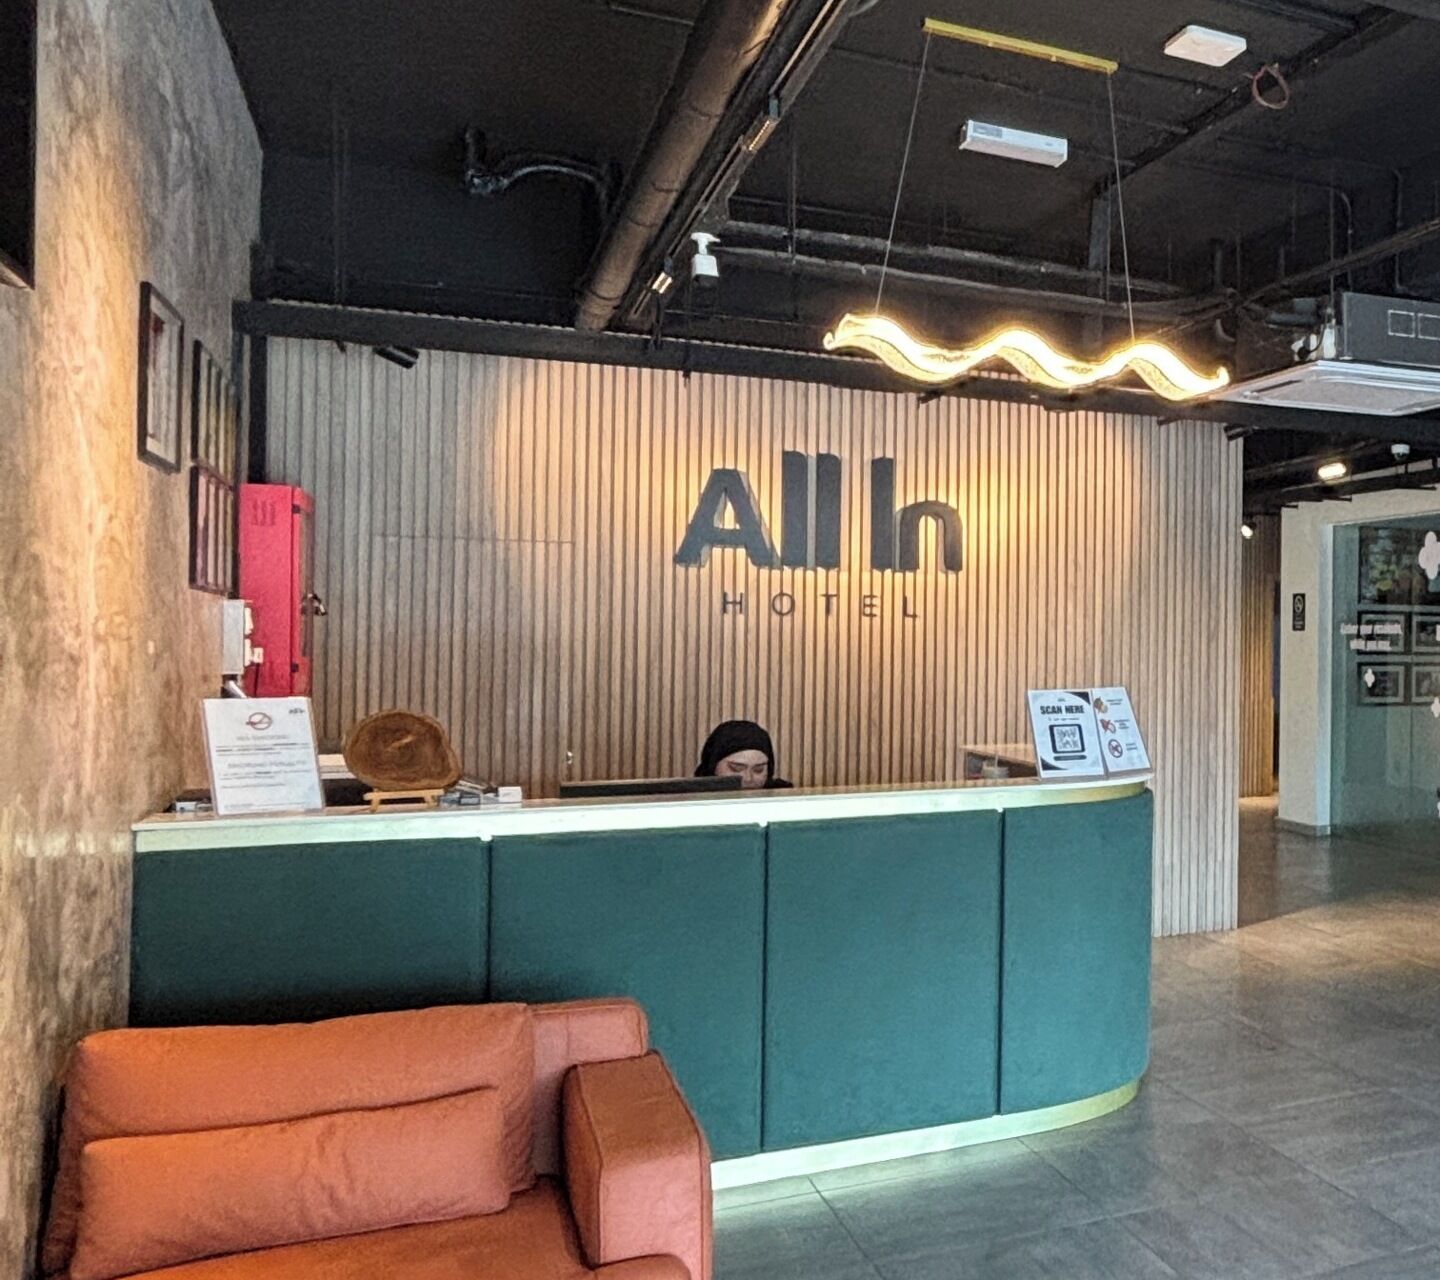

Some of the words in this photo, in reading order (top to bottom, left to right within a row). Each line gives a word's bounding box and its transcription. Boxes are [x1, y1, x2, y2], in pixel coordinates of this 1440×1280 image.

[674, 449, 842, 569] All
[721, 592, 919, 619] HOTEL
[1040, 705, 1062, 714] SCAN
[1065, 705, 1084, 714] HERE
